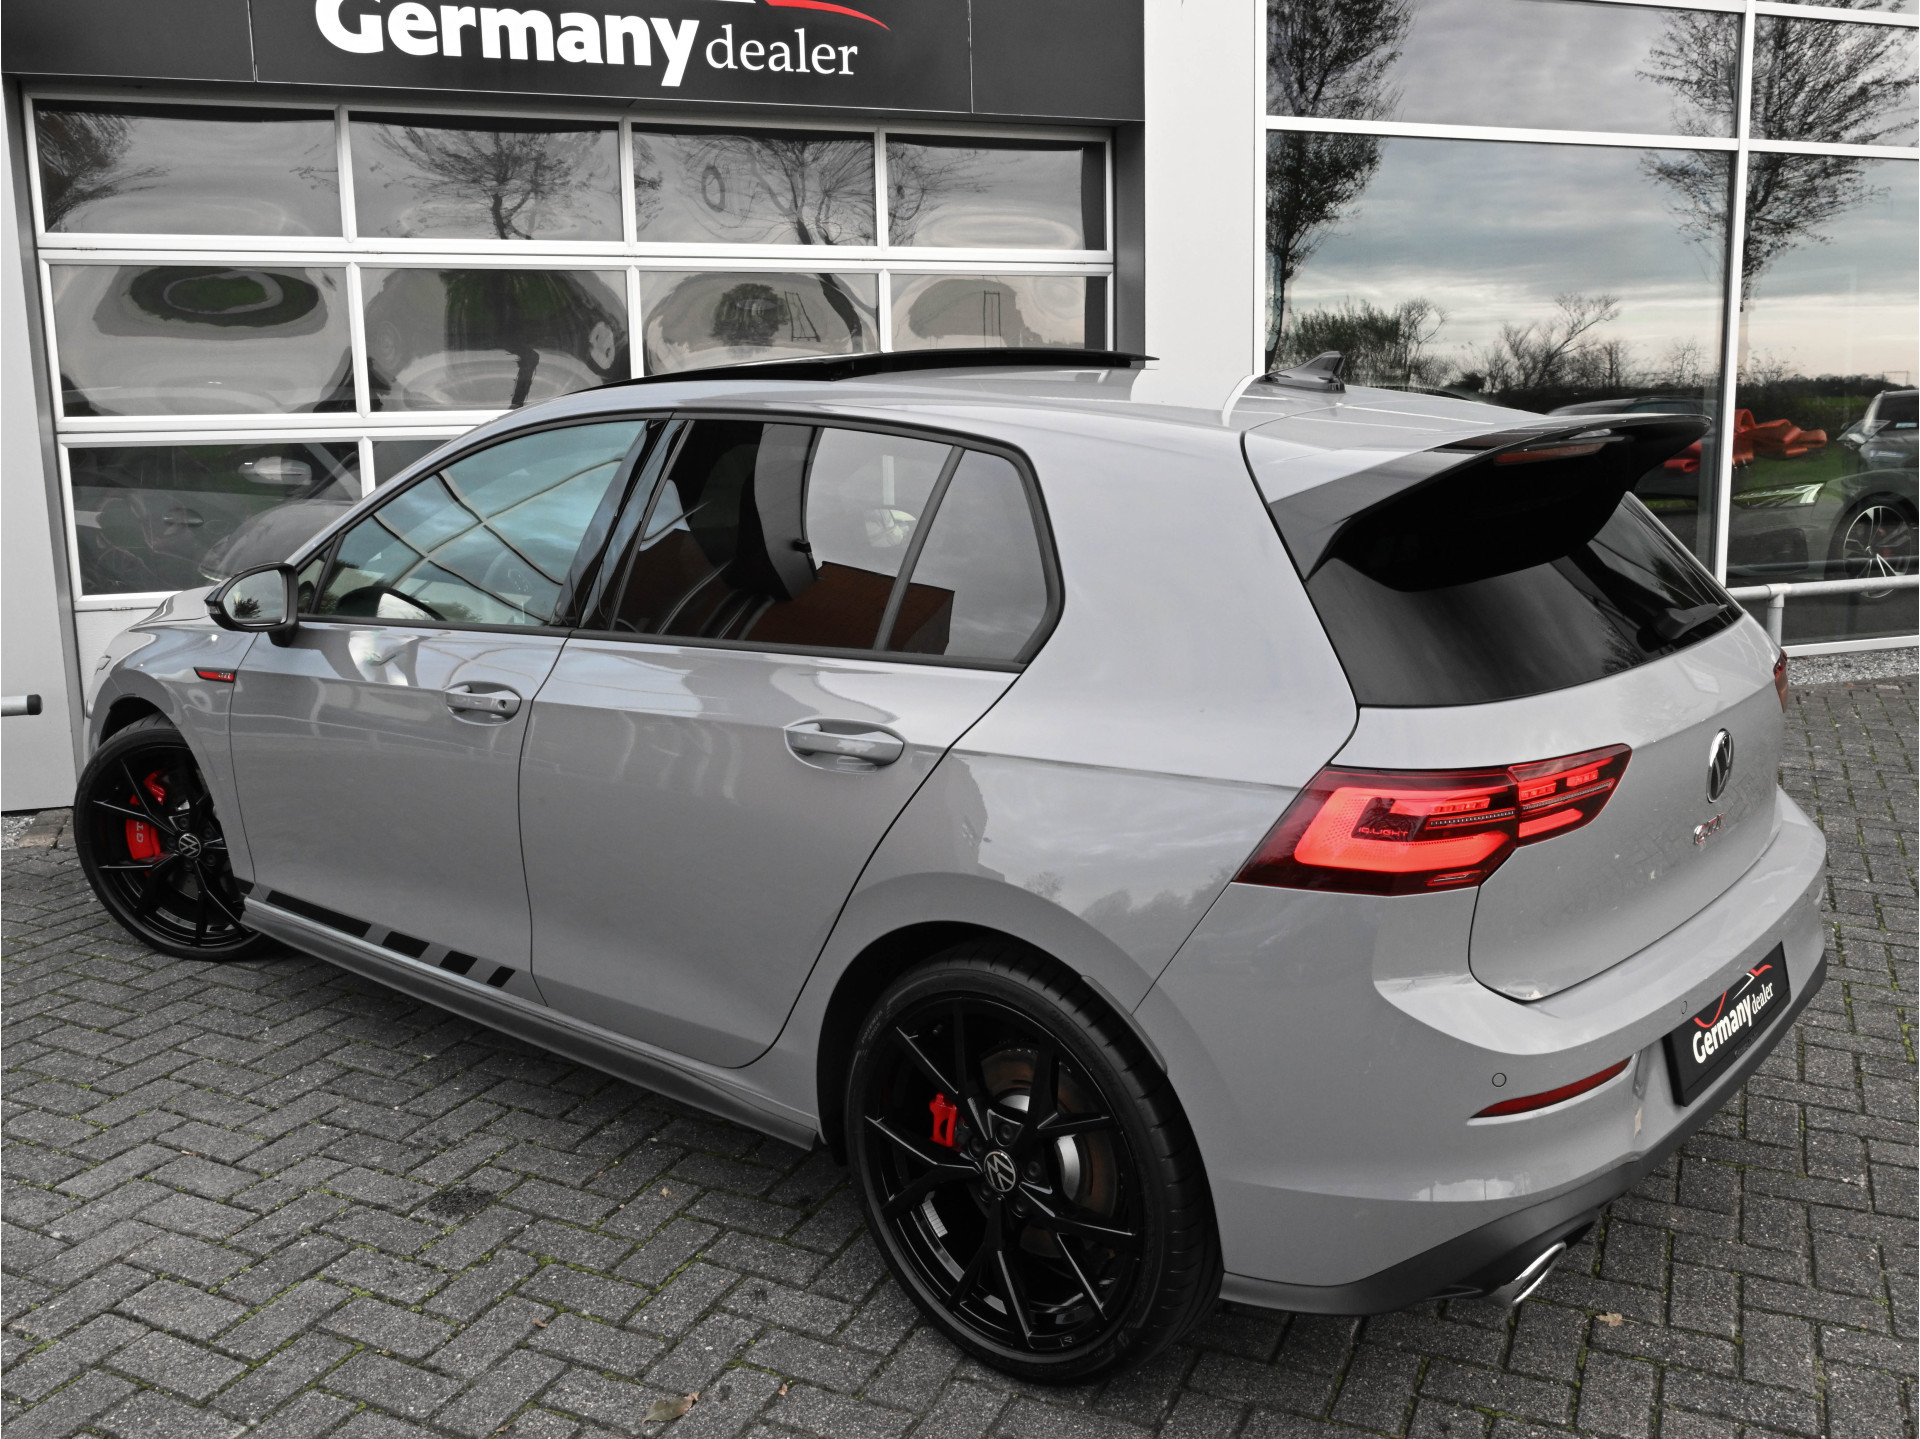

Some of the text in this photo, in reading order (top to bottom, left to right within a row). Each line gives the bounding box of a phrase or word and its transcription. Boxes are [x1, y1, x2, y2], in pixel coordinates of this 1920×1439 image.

[315, 0, 858, 87] Germany dealer
[136, 821, 144, 843] GT
[1692, 995, 1752, 1064] Germany
[1751, 982, 1774, 1015] dealer
